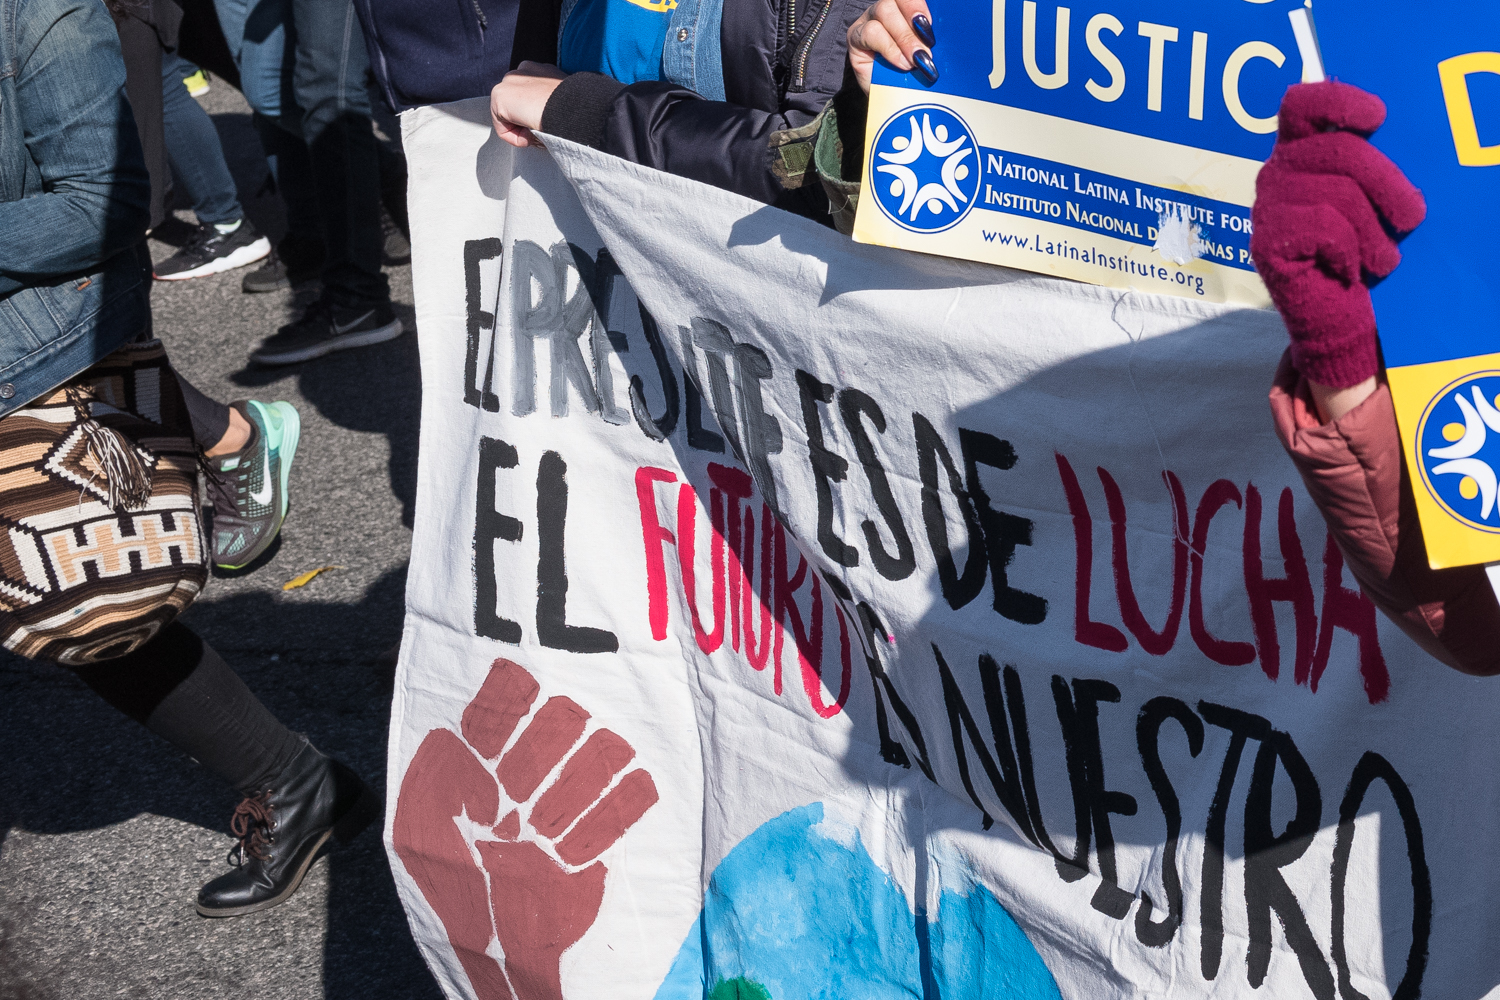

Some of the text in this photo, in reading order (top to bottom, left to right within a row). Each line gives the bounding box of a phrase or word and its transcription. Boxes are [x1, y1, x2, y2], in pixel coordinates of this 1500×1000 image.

[984, 184, 1062, 219] INSTITUTO
[1066, 201, 1143, 239] NACIONAL
[987, 154, 1069, 190] NATIONAL
[1074, 173, 1129, 206] LATINA
[795, 368, 915, 581] ES
[912, 411, 1048, 625] DE
[1054, 450, 1392, 705] LUCHA
[471, 436, 618, 653] EL
[931, 641, 1432, 1000] NUESTRO
